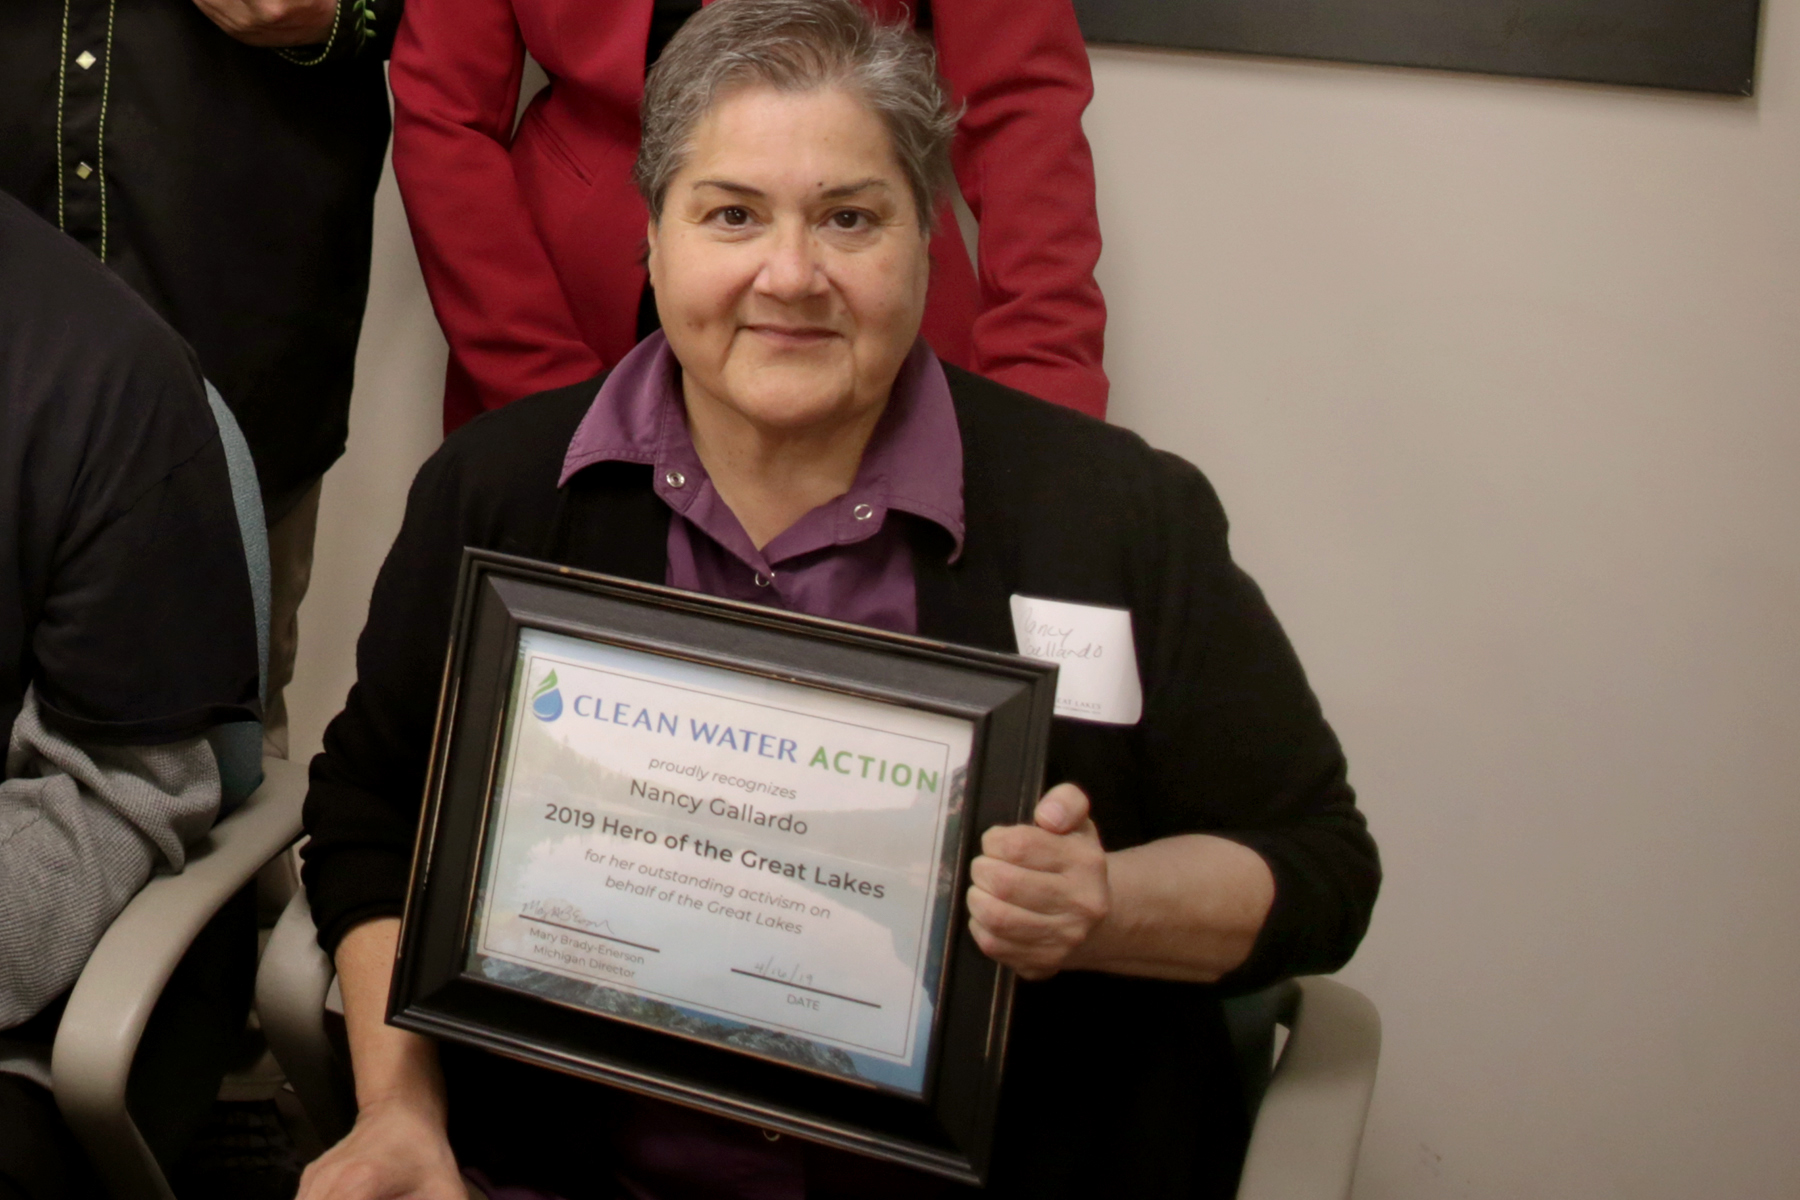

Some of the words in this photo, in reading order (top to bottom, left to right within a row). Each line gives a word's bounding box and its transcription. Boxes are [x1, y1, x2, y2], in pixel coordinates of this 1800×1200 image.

[573, 695, 678, 737] CLEAN
[690, 718, 798, 763] WATER
[808, 745, 938, 793] ACTION
[630, 779, 703, 814] Nancy
[709, 798, 808, 835] Gallardo
[648, 758, 709, 781] proudly
[711, 772, 797, 800] recognizes
[543, 803, 595, 829] 2019
[602, 816, 657, 844] Hero
[664, 834, 690, 851] of
[694, 839, 733, 862] the
[741, 850, 806, 881] Great
[814, 866, 885, 899] Lakes
[584, 849, 606, 864] for
[609, 855, 635, 871] her
[638, 864, 735, 898] outstanding
[738, 886, 806, 913] activism
[810, 905, 831, 919] on
[605, 875, 657, 898] behalf
[658, 890, 676, 902] of
[677, 894, 704, 911] the
[707, 900, 752, 923] Great
[755, 912, 803, 935] Lakes
[529, 927, 557, 944] Mary
[560, 934, 645, 965] Brady-Enerson
[533, 944, 586, 966] Michigan
[589, 958, 636, 978] Director
[787, 993, 821, 1011] DATE
